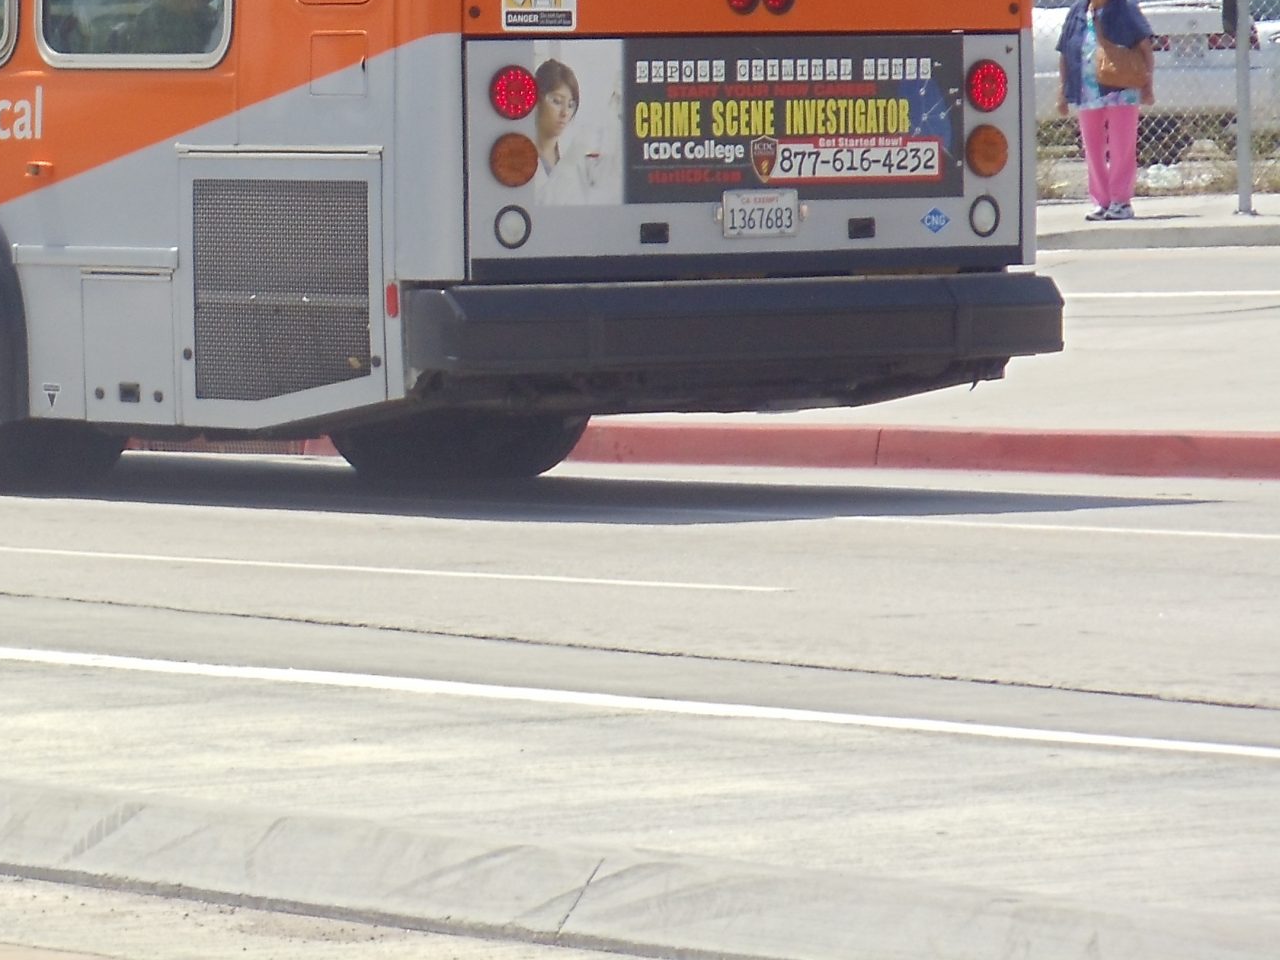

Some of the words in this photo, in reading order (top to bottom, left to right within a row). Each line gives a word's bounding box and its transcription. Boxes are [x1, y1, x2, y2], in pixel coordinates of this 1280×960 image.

[507, 14, 539, 23] DANGER
[636, 60, 725, 82] EXPOSE
[737, 58, 852, 81] CRIMINAL
[863, 58, 931, 80] MINDS
[635, 101, 700, 137] CRIME
[712, 100, 774, 136] SCENE
[786, 98, 910, 136] INVESTIGATOR
[643, 141, 681, 160] ICDC
[685, 139, 744, 163] College
[780, 147, 935, 176] 877-616-4232
[729, 207, 793, 231] 1367683
[925, 215, 946, 226] CNG
